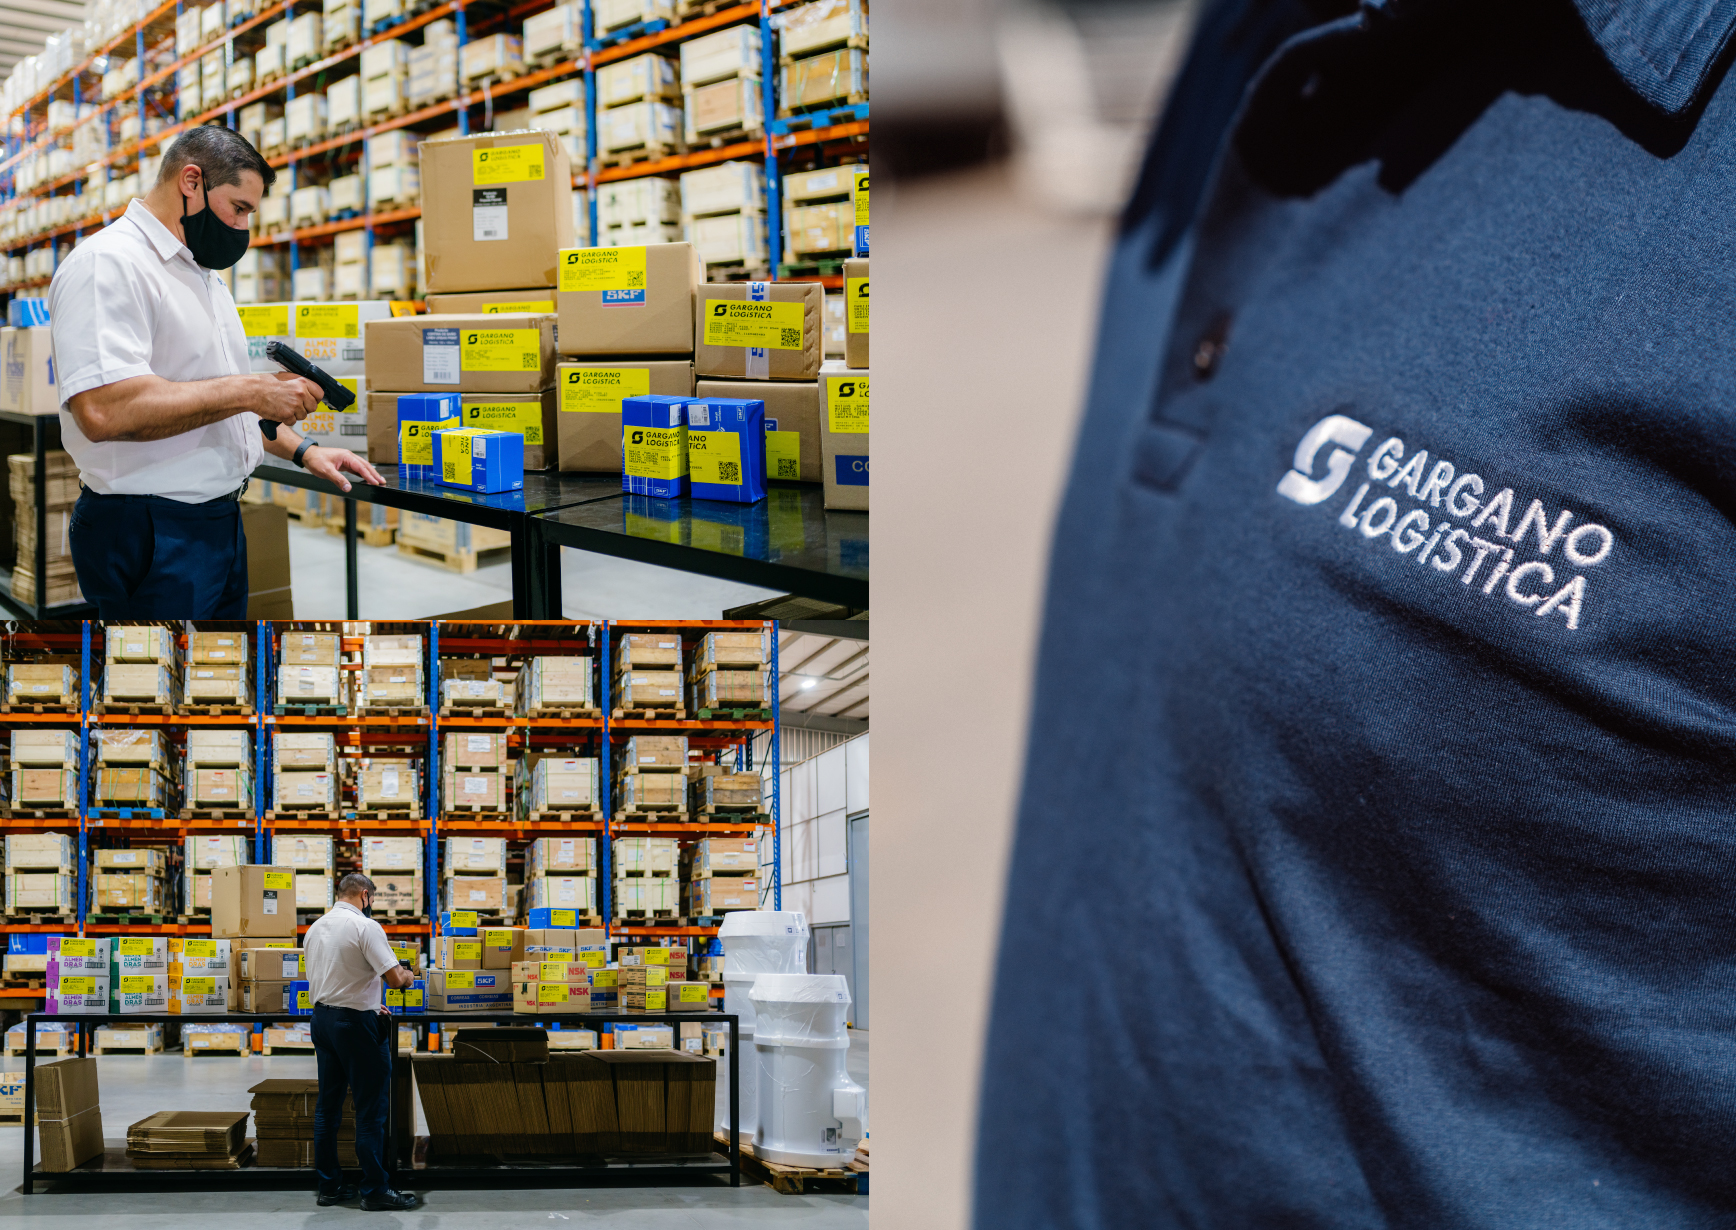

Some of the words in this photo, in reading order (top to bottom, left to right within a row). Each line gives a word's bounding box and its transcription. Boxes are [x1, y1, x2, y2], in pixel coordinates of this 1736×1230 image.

[606, 289, 642, 300] SKF
[730, 304, 773, 312] GARGANO
[304, 339, 337, 347] ALMEN
[304, 348, 337, 358] DRAS
[302, 422, 335, 432] DRAS
[646, 431, 681, 439] GARGANO
[1368, 437, 1614, 566] GARGANO
[568, 967, 586, 975] NSK
[669, 971, 686, 979] NSK
[569, 987, 589, 995] NSK
